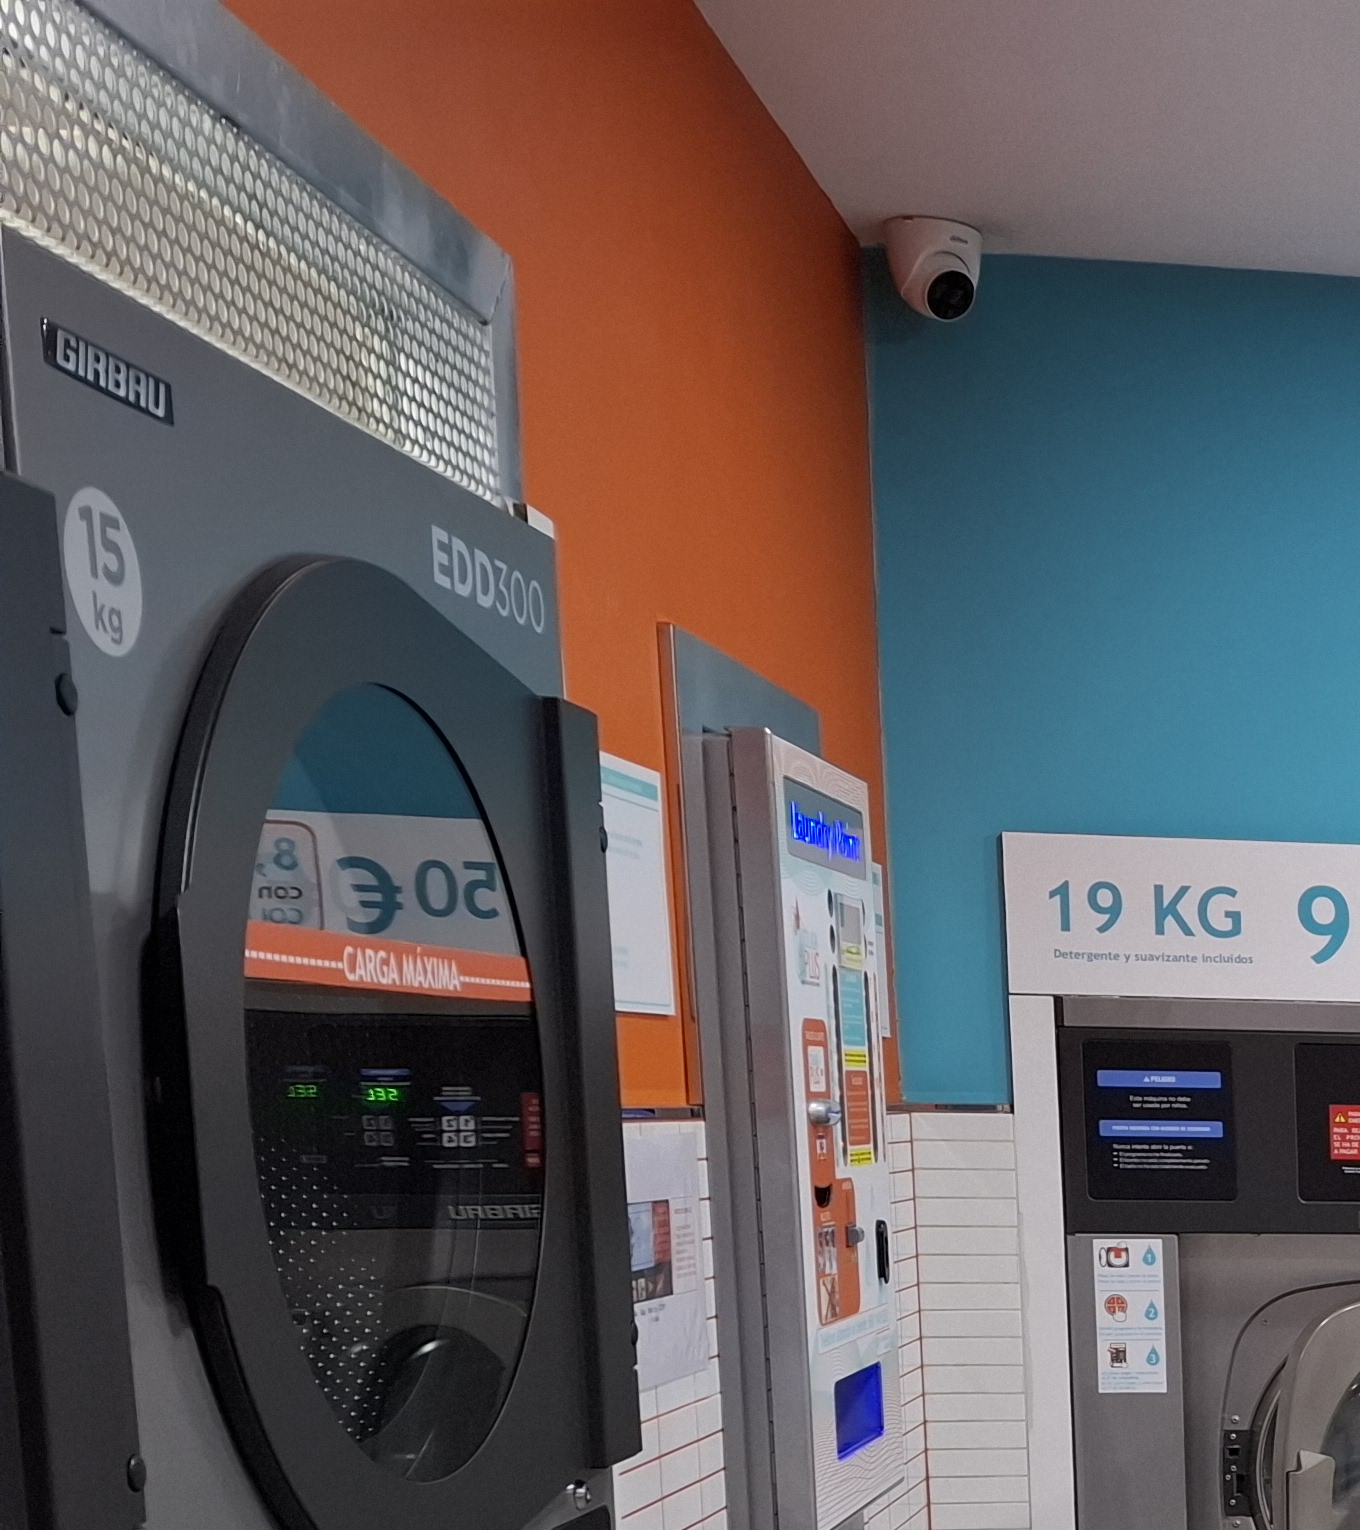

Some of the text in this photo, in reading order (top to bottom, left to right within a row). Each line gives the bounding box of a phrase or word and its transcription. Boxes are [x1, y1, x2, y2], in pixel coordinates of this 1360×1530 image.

[56, 329, 166, 418] GIRBAU
[78, 505, 125, 587] 15
[431, 524, 545, 634] EDD300
[92, 590, 123, 645] kg
[1048, 879, 1241, 938] 19 KG
[343, 945, 461, 991] CARGA MÁXIMA
[1053, 948, 1253, 963] Detergente y suavizante incluidos
